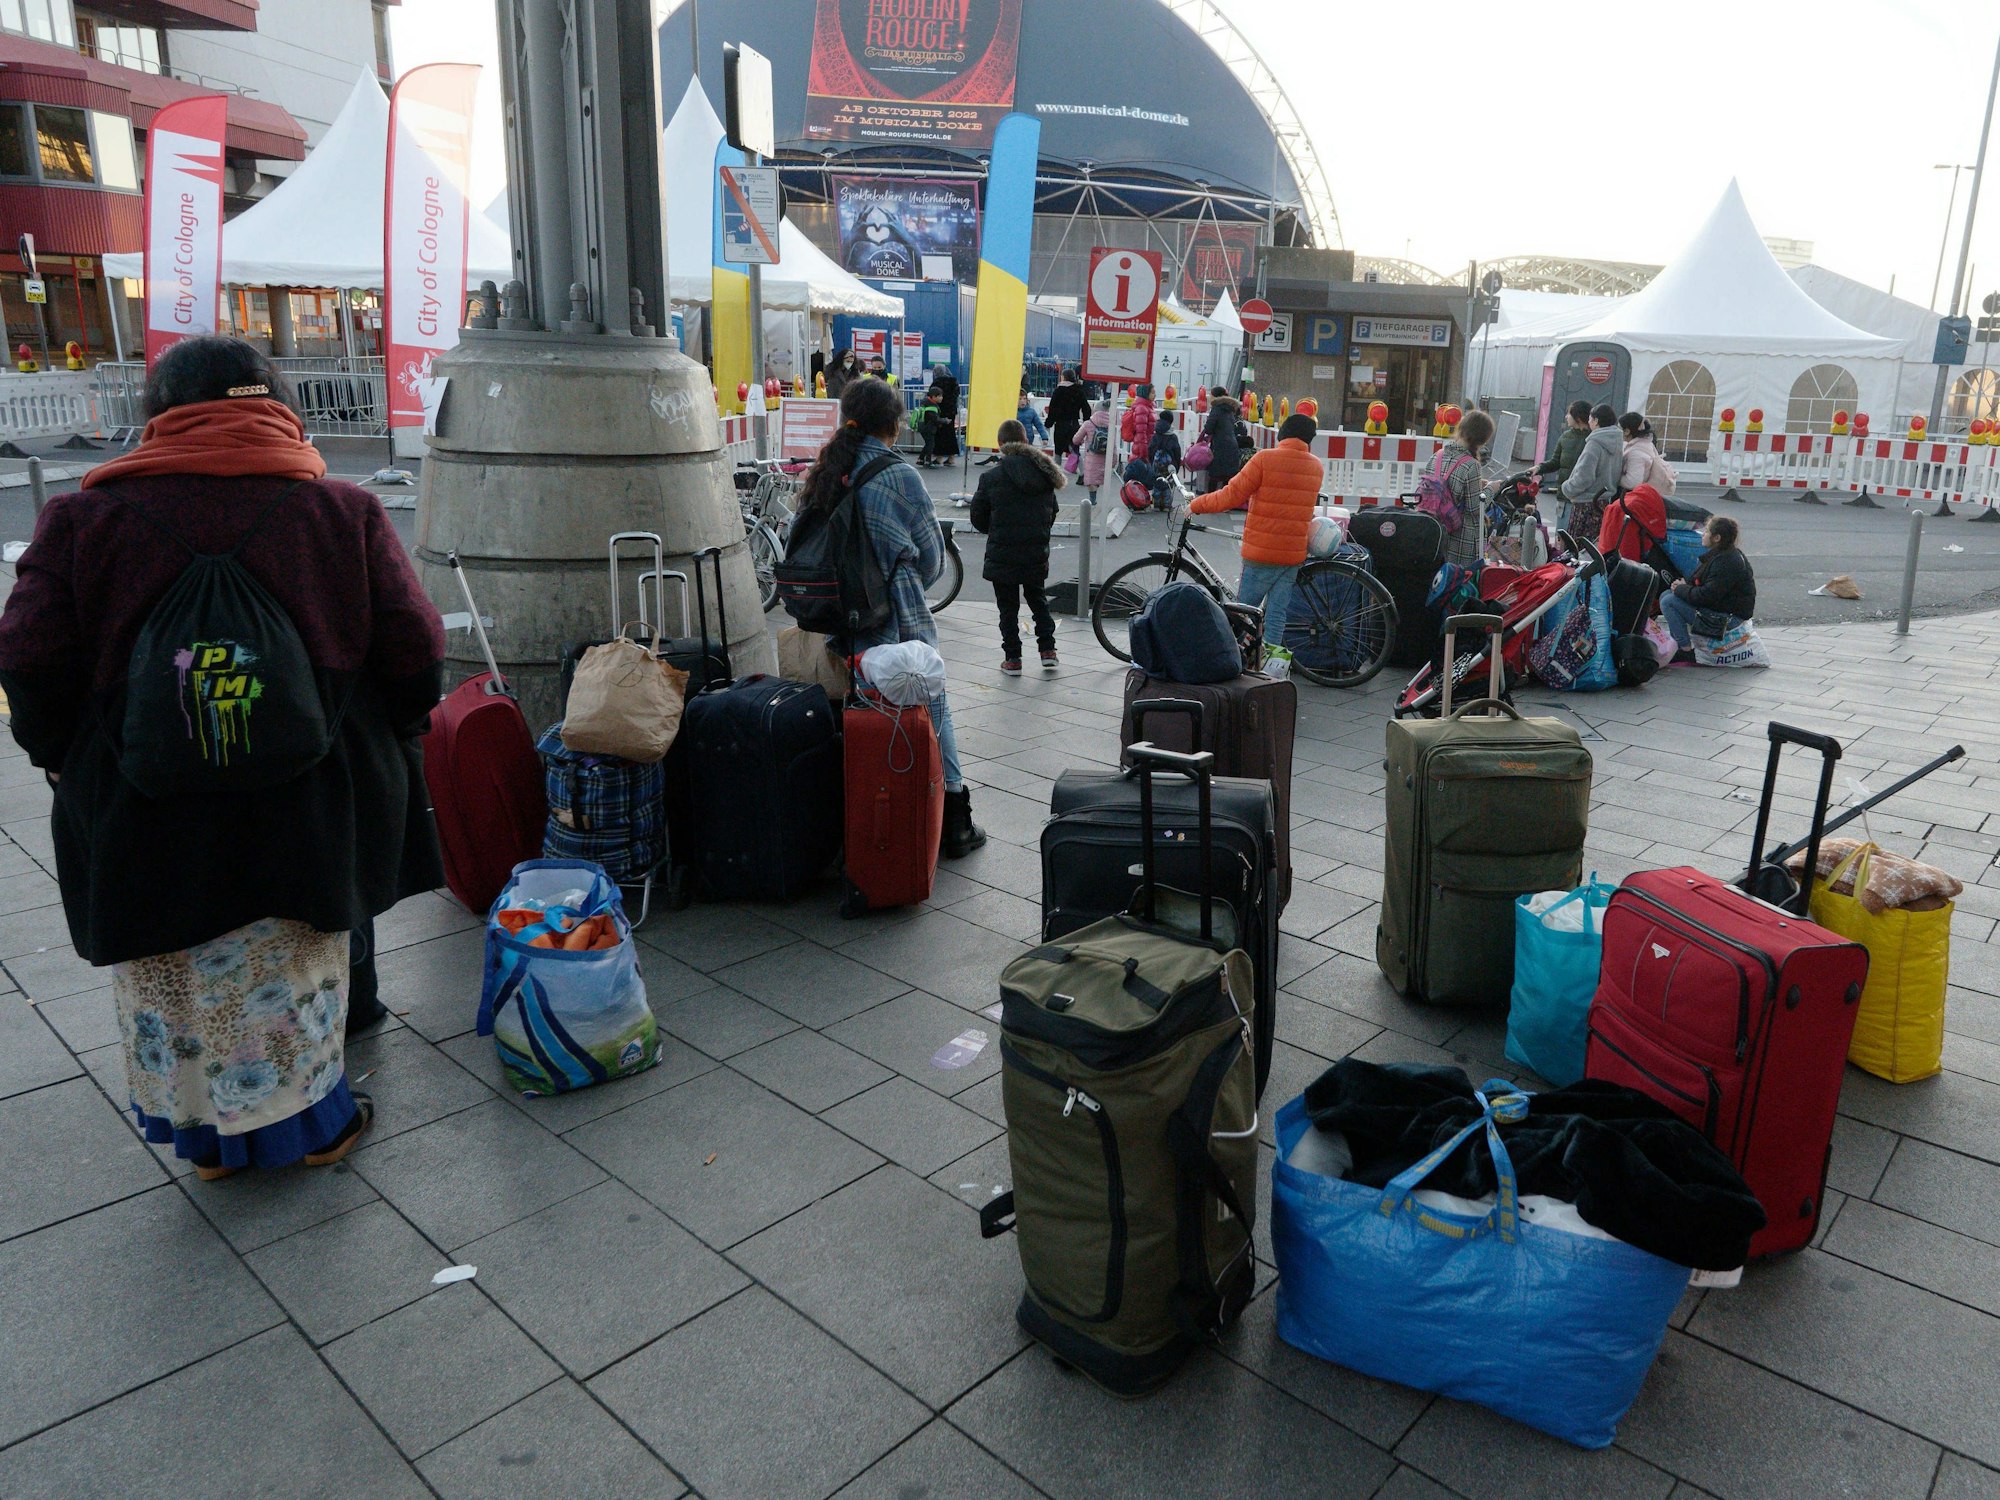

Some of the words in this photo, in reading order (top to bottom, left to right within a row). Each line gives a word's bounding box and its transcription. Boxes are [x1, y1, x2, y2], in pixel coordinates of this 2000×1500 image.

[840, 104, 863, 113] AB
[867, 106, 944, 119] OKTOBER
[947, 110, 978, 119] 2022
[1035, 103, 1189, 126] www.musical-dome.de
[833, 115, 855, 124] IM
[859, 116, 932, 129] MUSICAL
[936, 121, 983, 131] DOME
[861, 130, 952, 141] MOULIN-ROUGE-MUSICAL.DE
[840, 186, 904, 203] Spektakuläre
[908, 191, 971, 210] Unterhaltung
[174, 192, 199, 265] Cologne
[417, 176, 444, 264] Cologne
[870, 260, 905, 270] MUSICAL
[876, 267, 900, 277] DOME
[173, 266, 193, 287] of
[416, 266, 438, 290] of
[174, 291, 198, 325] City
[417, 295, 442, 337] City
[1087, 316, 1153, 331] Information
[1313, 318, 1337, 350] P
[1374, 322, 1430, 333] TIEFGARAGE
[1716, 648, 1754, 665] ACTION
